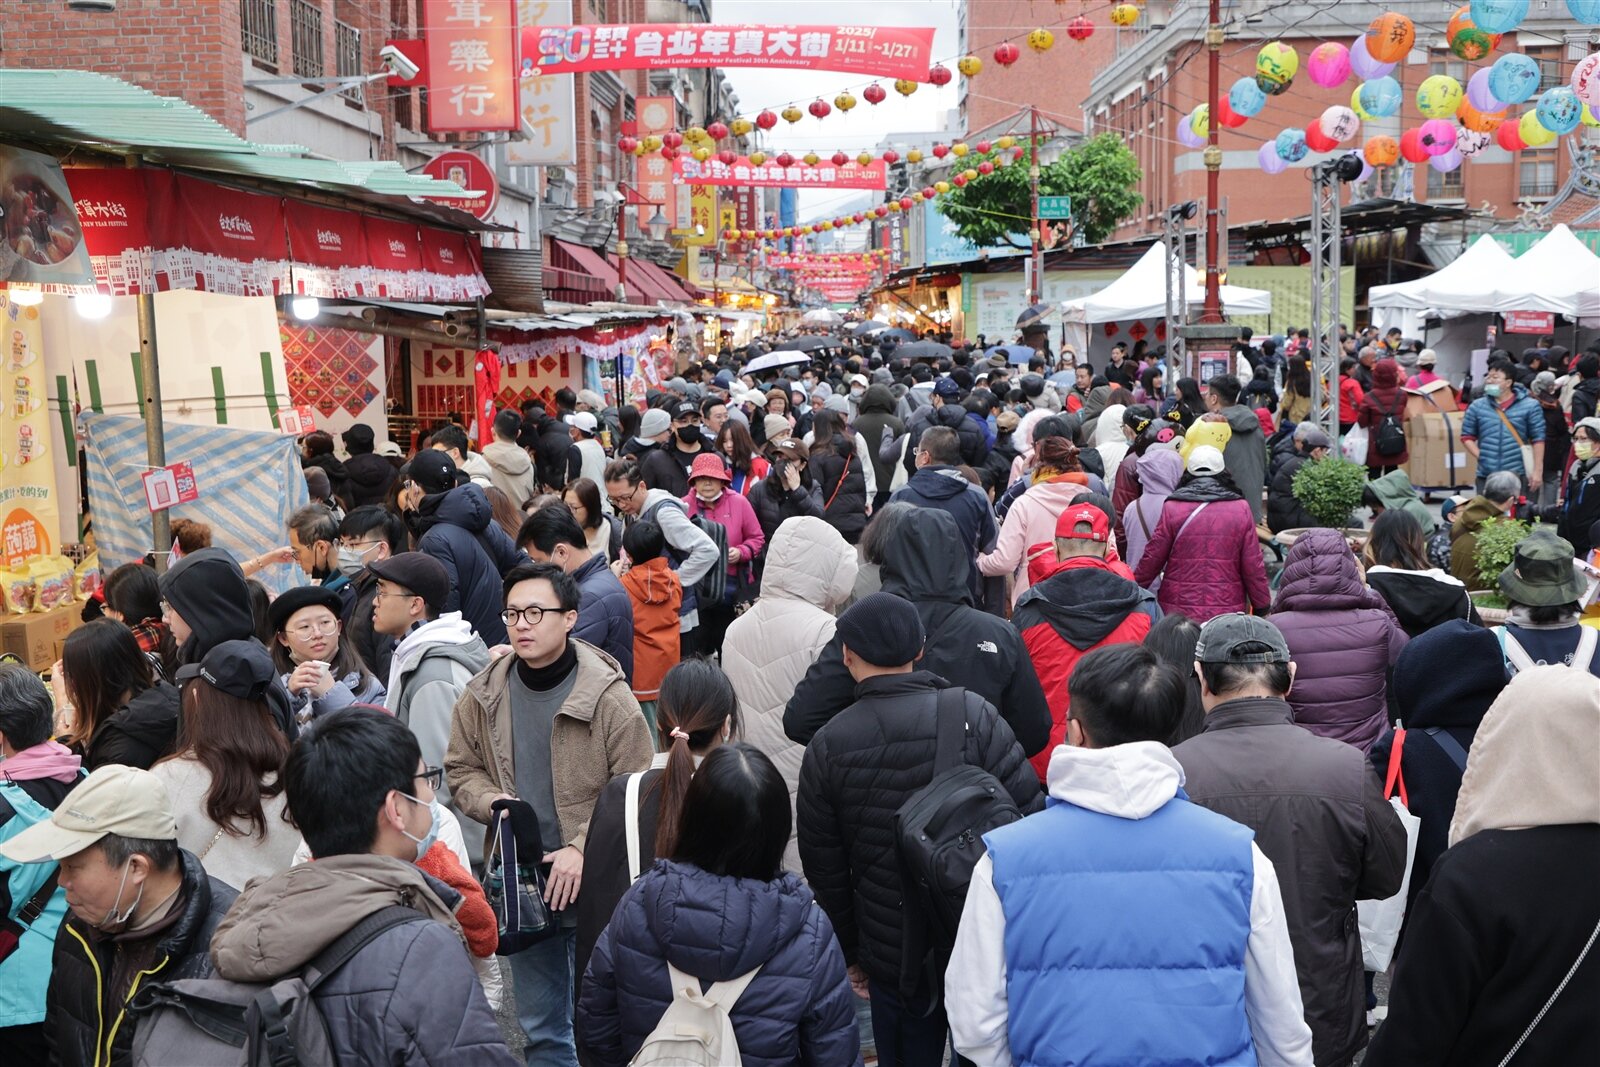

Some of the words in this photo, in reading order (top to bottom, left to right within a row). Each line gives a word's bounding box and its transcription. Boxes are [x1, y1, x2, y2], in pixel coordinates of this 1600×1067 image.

[634, 30, 831, 57] 台北年貨大街
[835, 39, 865, 54] 1/11
